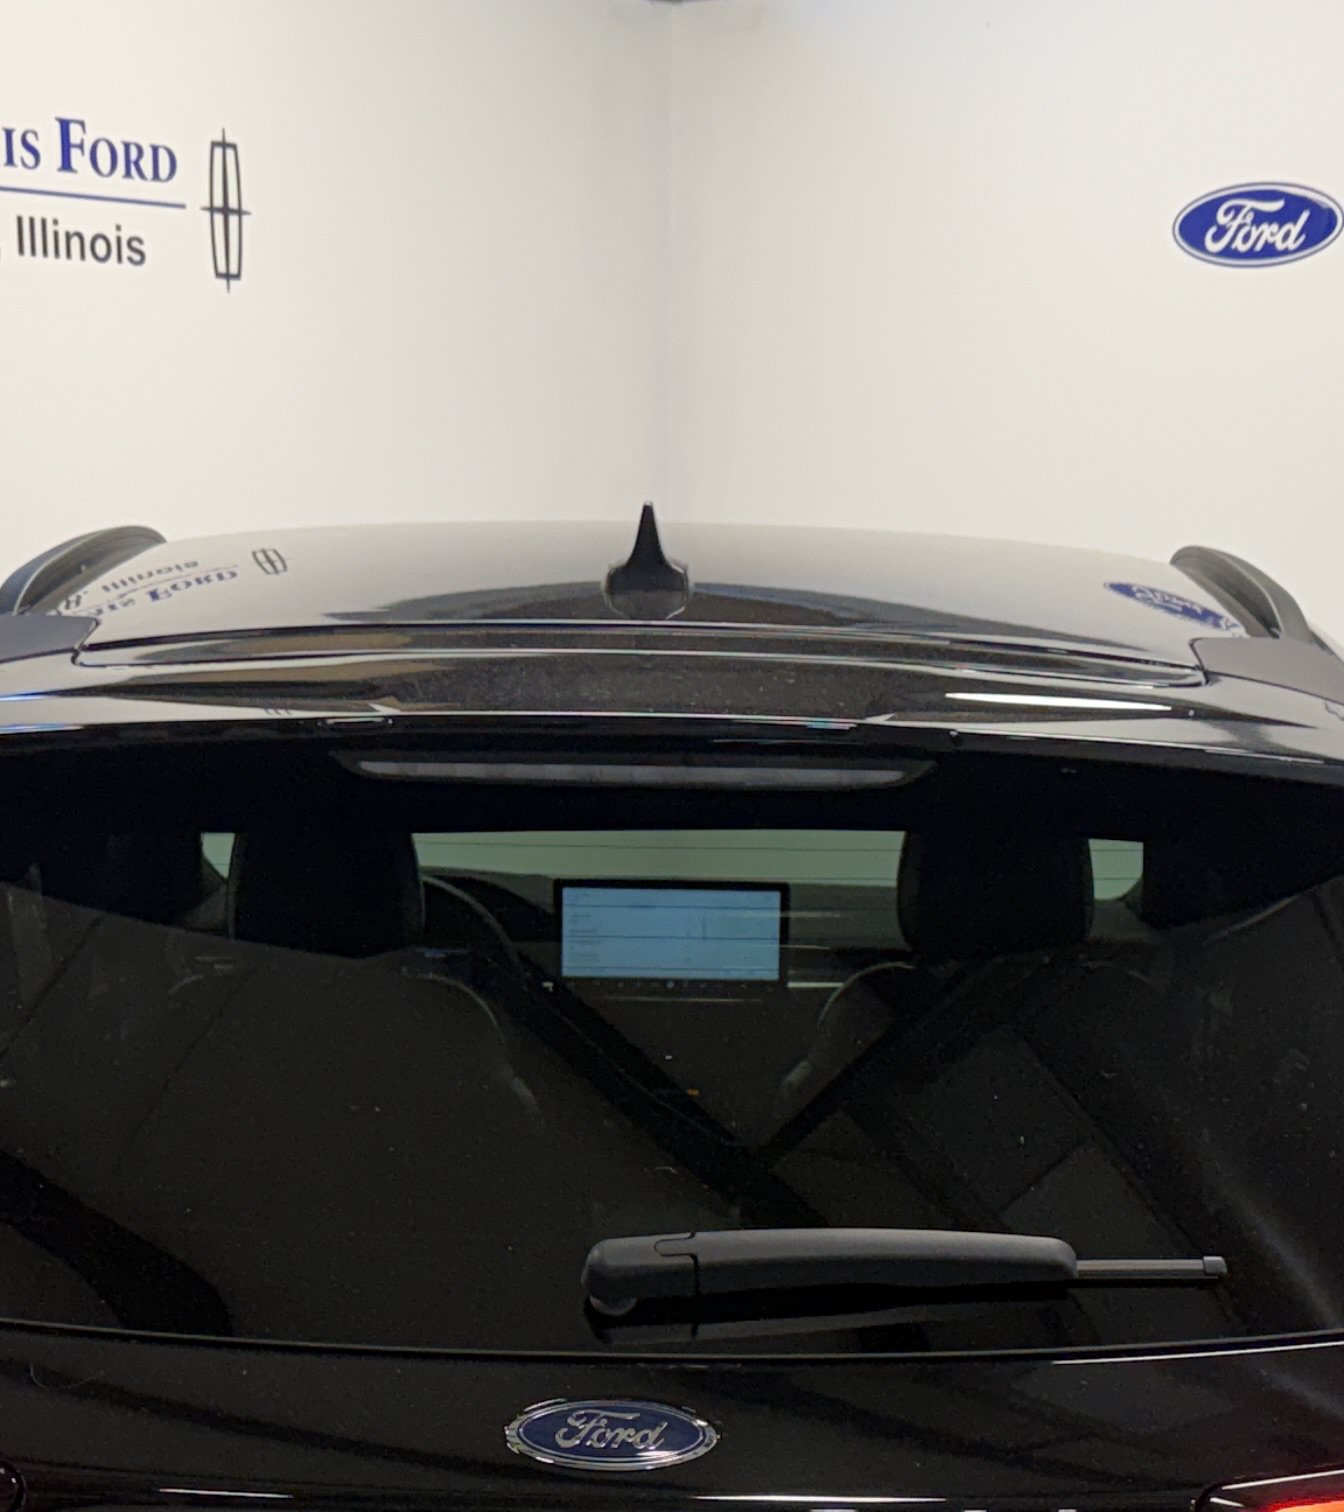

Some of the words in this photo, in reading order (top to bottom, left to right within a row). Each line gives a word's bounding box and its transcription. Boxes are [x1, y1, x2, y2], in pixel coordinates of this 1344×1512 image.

[56, 117, 179, 184] FORD
[16, 215, 148, 267] Illinois
[1203, 197, 1307, 255] Ford
[555, 1411, 666, 1450] Ford
